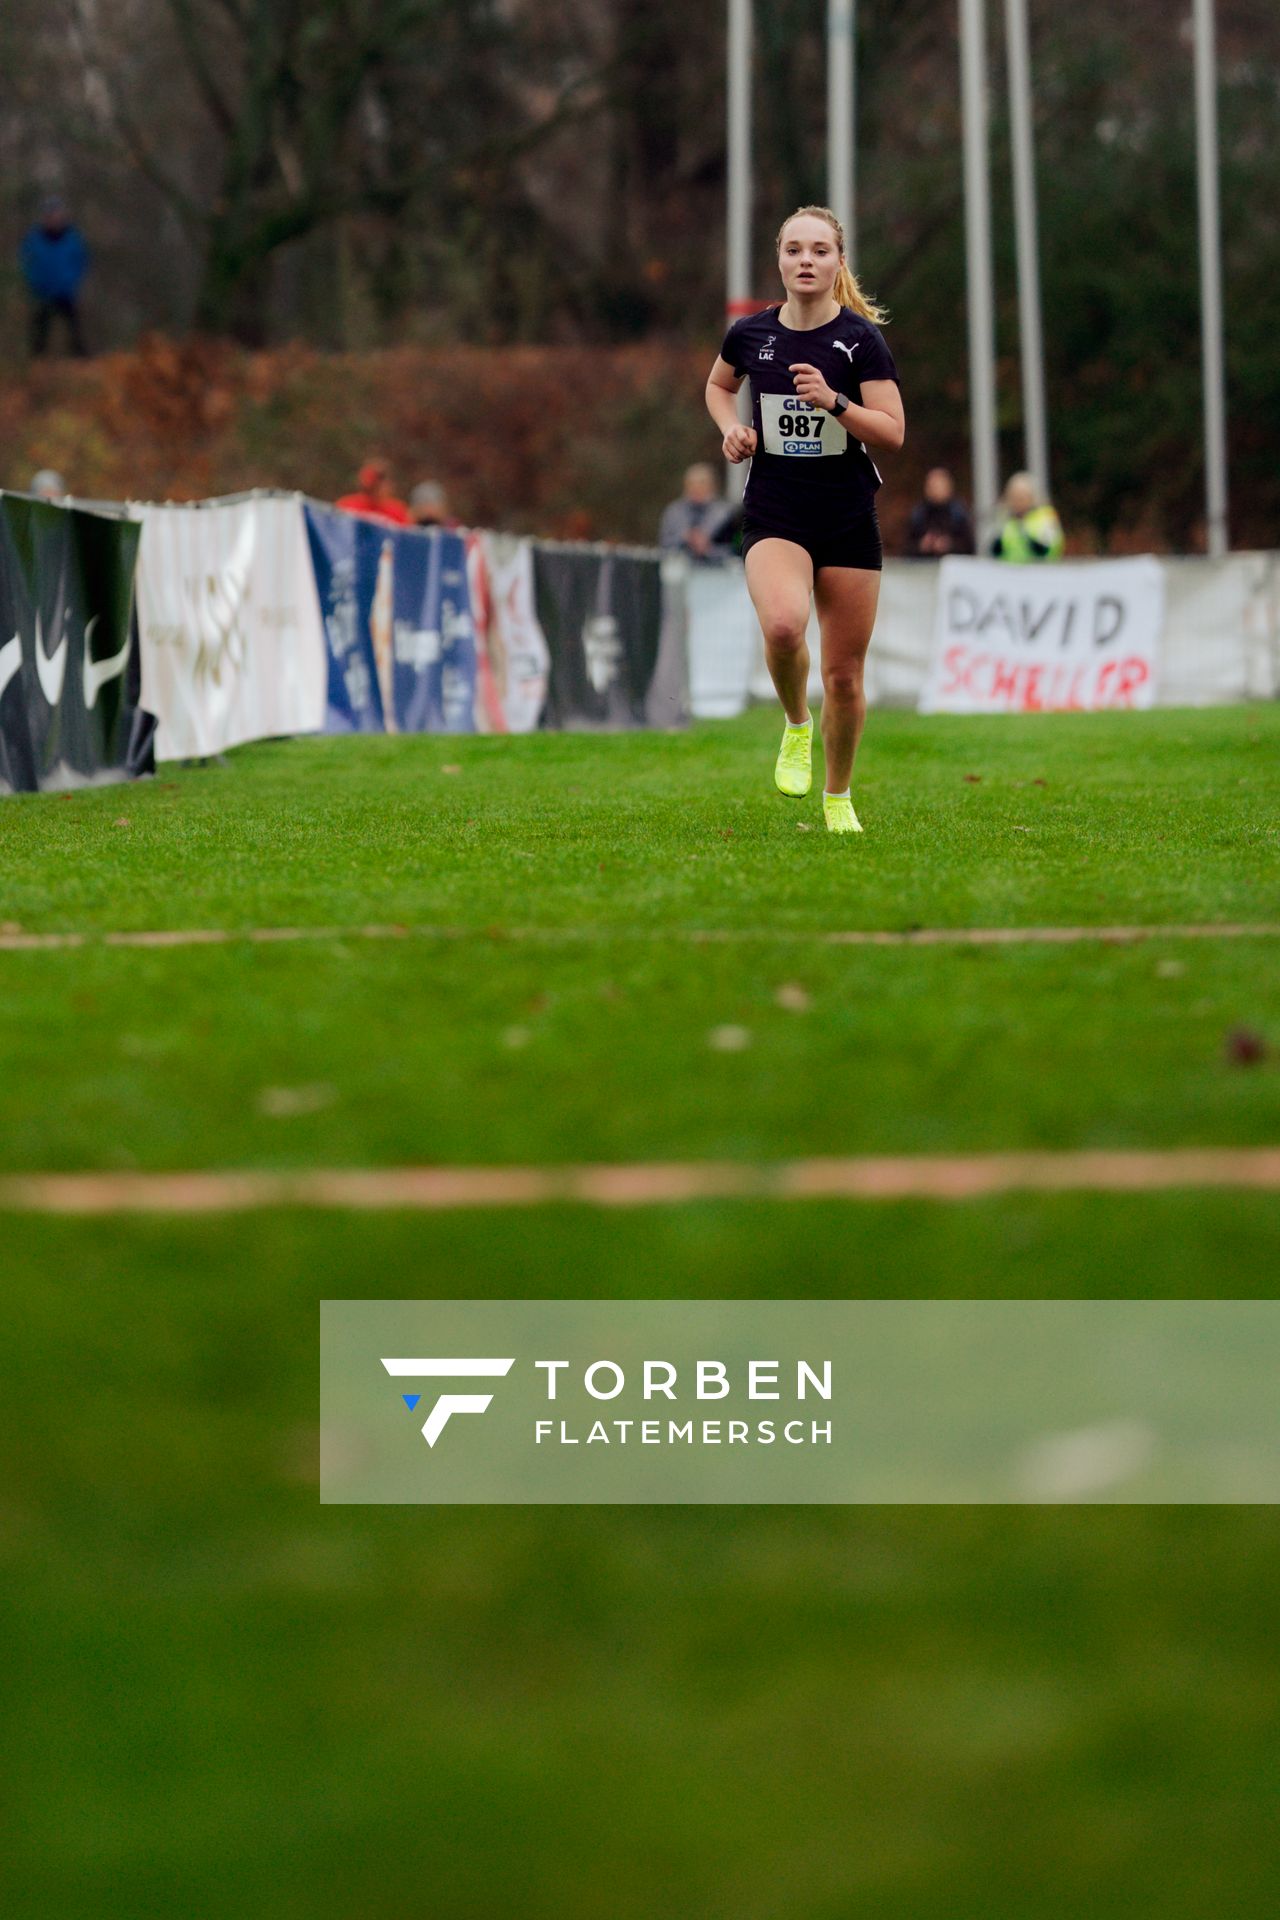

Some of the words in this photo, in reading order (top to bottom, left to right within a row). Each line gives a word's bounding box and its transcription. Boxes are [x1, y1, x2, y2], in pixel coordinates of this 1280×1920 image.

[759, 352, 774, 360] LAC
[778, 414, 825, 438] 987
[948, 585, 1126, 647] DAVID
